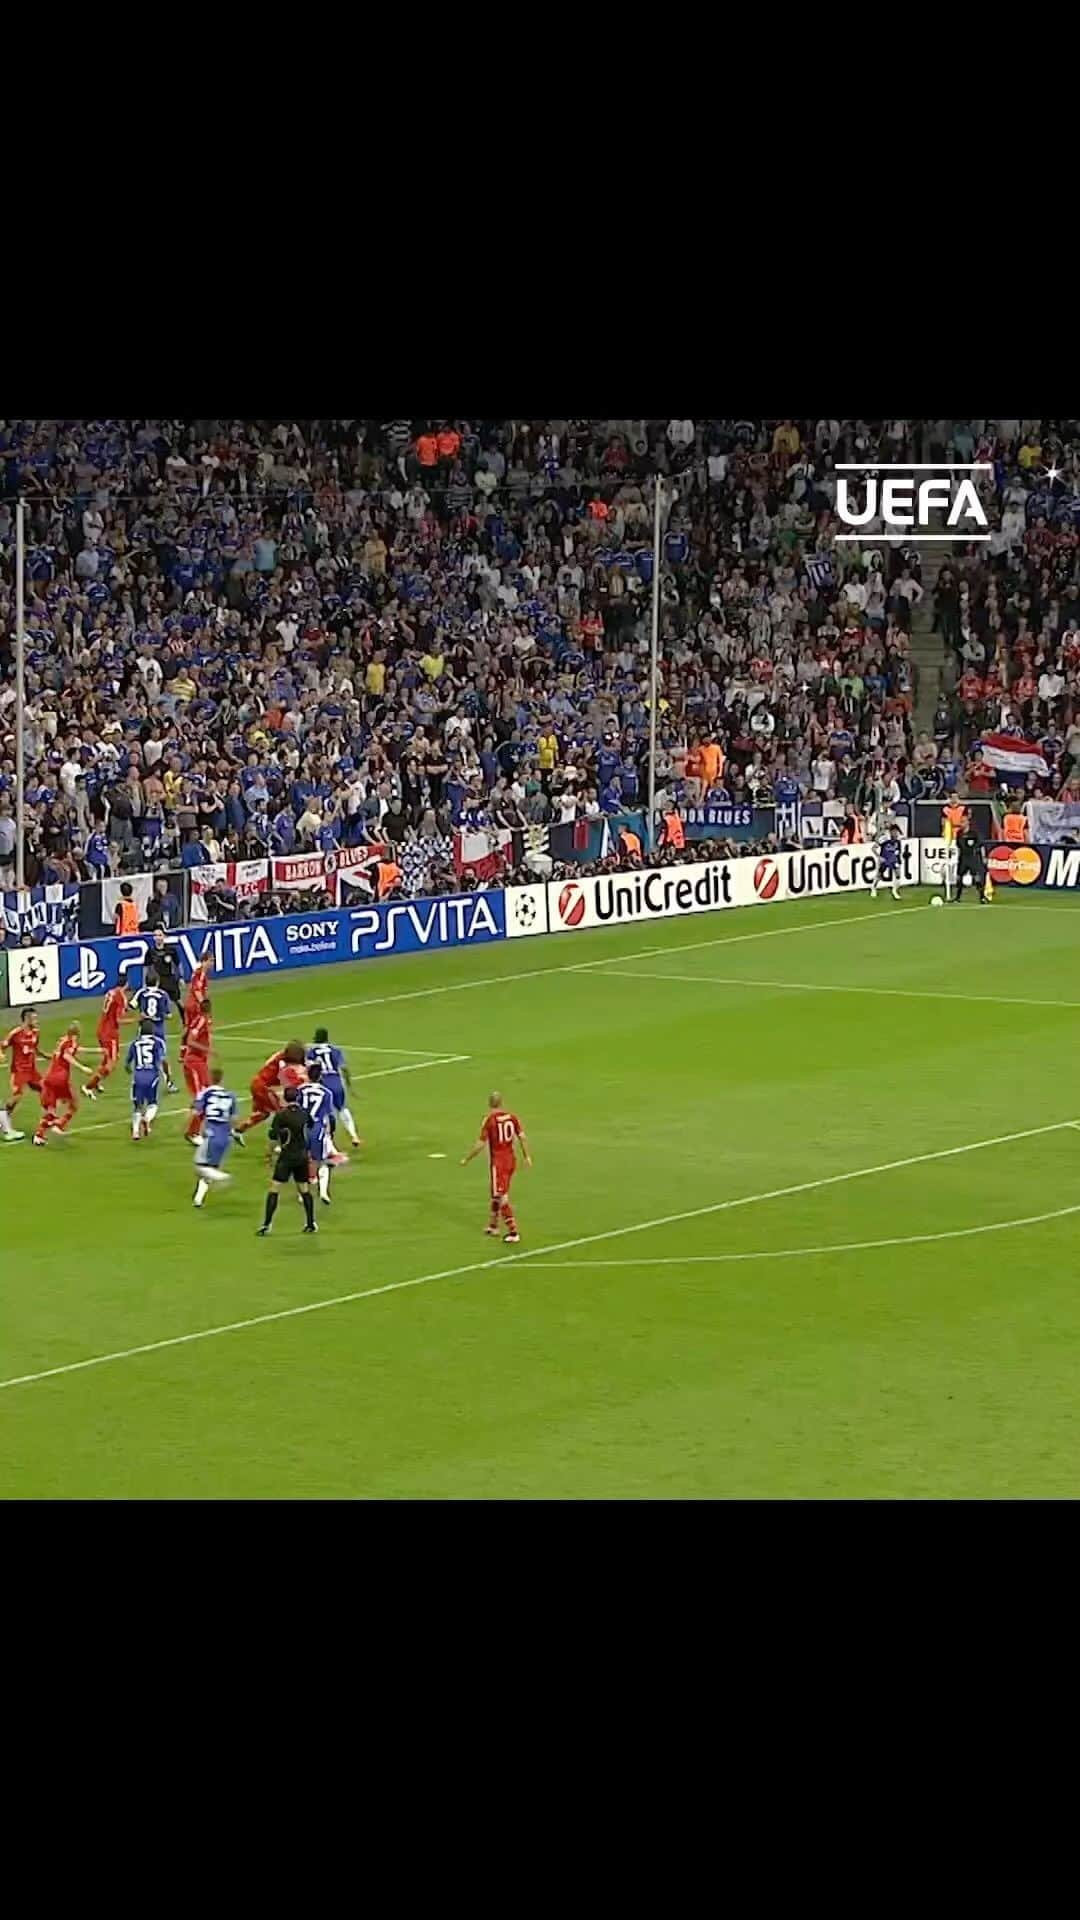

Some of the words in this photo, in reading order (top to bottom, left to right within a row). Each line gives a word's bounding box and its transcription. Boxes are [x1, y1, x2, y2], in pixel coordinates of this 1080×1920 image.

[708, 809, 750, 825] BLUES
[788, 843, 912, 894] UniCret
[594, 863, 732, 920] UniCredit
[286, 920, 340, 942] SONY
[147, 997, 158, 1017] 8
[136, 1044, 154, 1067] 15
[302, 1094, 324, 1118] 17
[497, 1120, 515, 1143] 10
